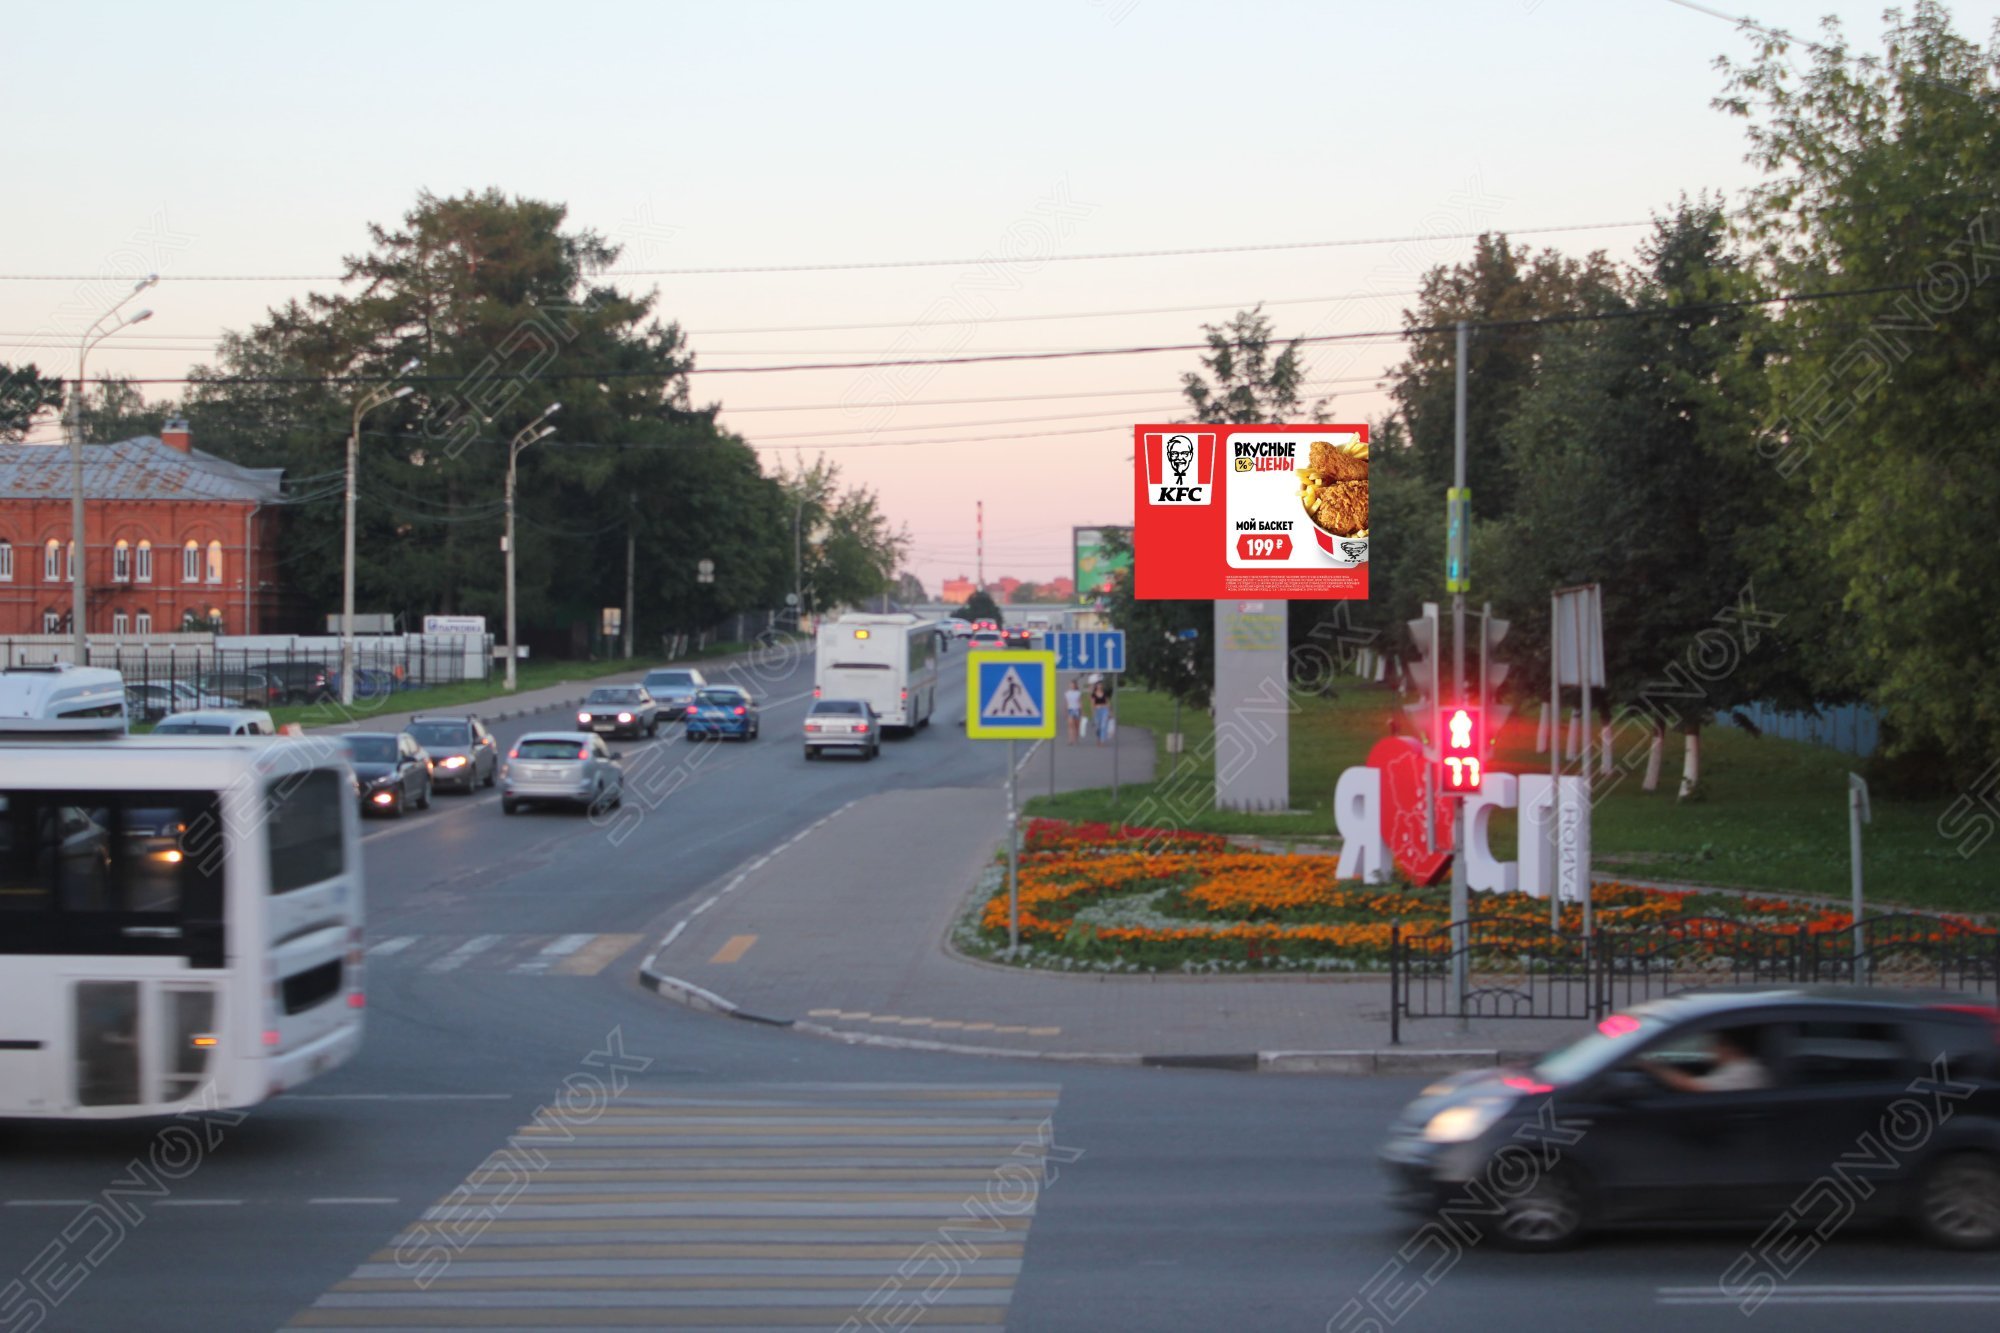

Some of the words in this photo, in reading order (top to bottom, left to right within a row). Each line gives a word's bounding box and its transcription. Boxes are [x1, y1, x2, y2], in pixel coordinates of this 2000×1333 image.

[1234, 441, 1296, 457] ВКУСНЫЕ
[1255, 457, 1294, 472] ЦЕНЫ
[1158, 487, 1202, 502] KFC
[1236, 518, 1256, 531] МОЙ
[1258, 520, 1293, 531] БАСКЕТ
[1246, 538, 1274, 556] 199
[1443, 757, 1480, 787] 77
[1334, 766, 1388, 884] Я
